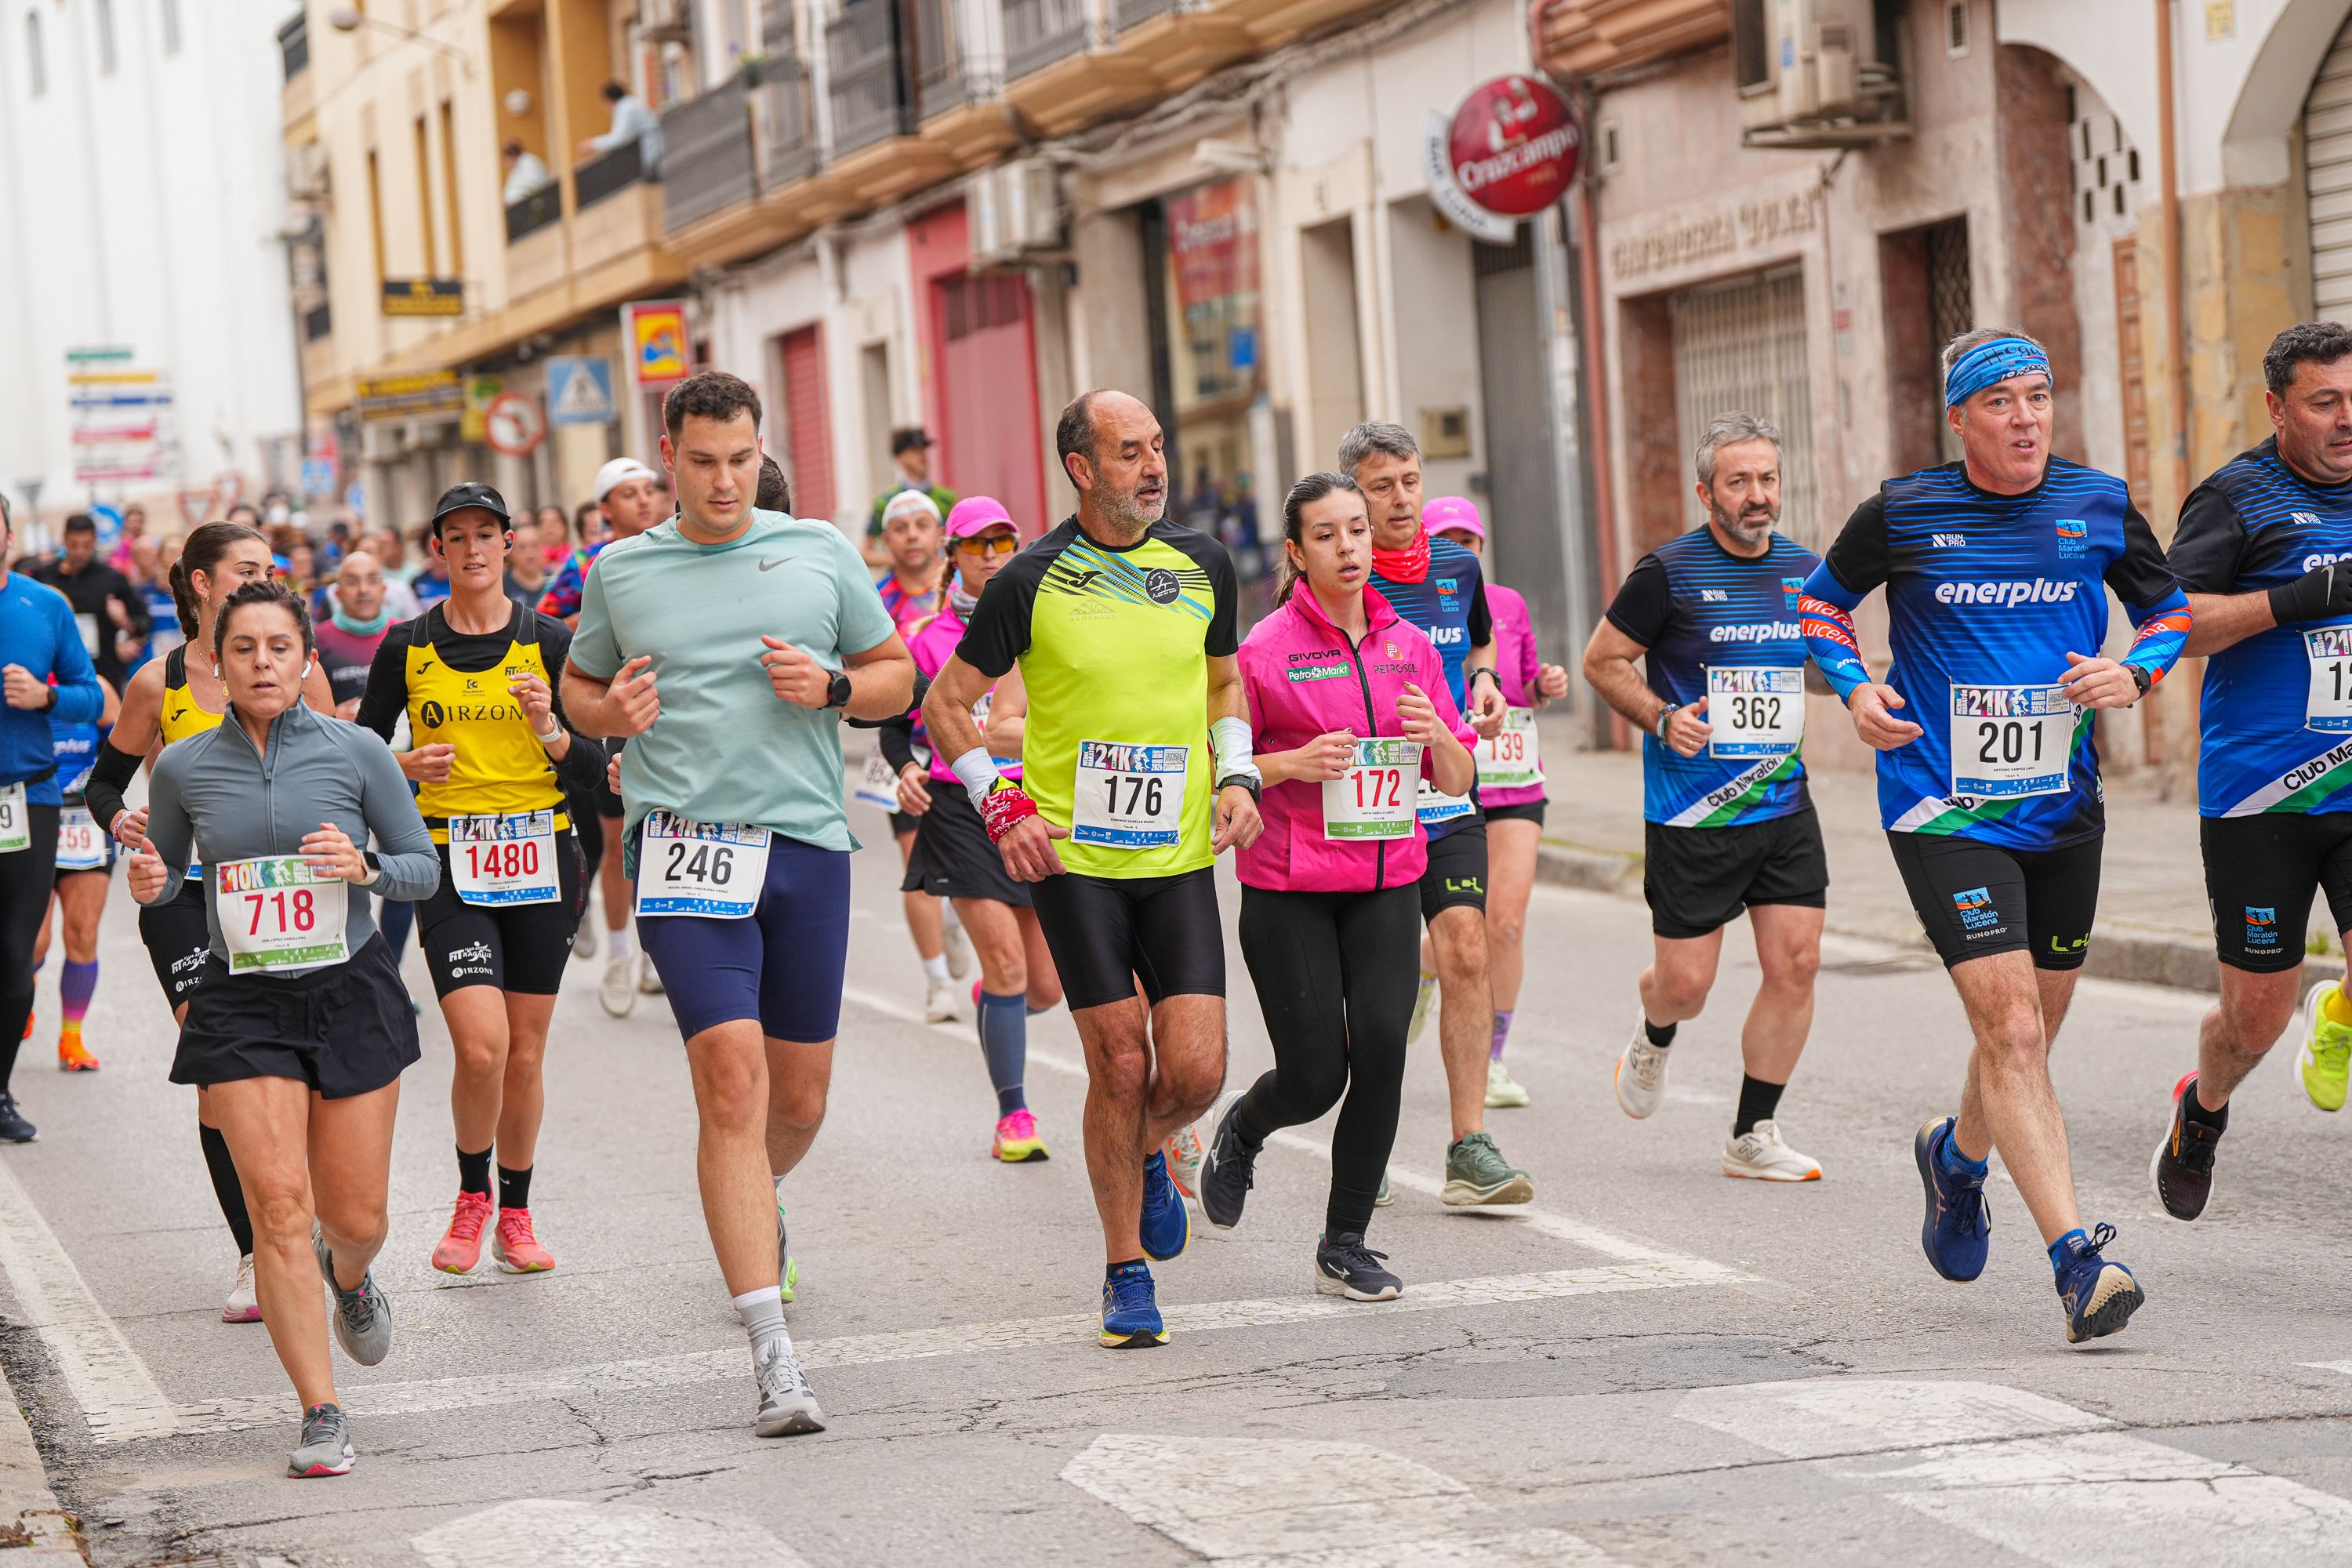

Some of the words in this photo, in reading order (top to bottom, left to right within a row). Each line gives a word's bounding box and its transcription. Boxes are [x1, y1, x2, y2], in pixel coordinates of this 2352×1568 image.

[1457, 124, 1579, 192] Cruzcampo
[2058, 537, 2076, 546] Club
[1934, 577, 2078, 608] enerplus
[1709, 620, 1801, 644] enerplus
[2325, 629, 2352, 656] 21
[1288, 649, 1341, 662] GIVOVA
[1374, 663, 1417, 674] PETROSOL
[1723, 670, 1755, 692] 21K
[1732, 696, 1781, 729] 362
[1969, 689, 2009, 716] 21K
[2031, 706, 2045, 714] 2026
[1491, 733, 1524, 760] 139
[1978, 720, 2043, 764] 201
[1094, 744, 1131, 771] 21K
[1151, 763, 1163, 771] 2026
[2283, 755, 2327, 792] Club
[1105, 775, 1163, 816] 176
[1350, 769, 1400, 808] 172
[1707, 785, 1737, 807] Club
[465, 818, 498, 841] 21K
[662, 812, 699, 837] 21K
[720, 833, 736, 842] 2026
[466, 841, 539, 878] 1480
[665, 842, 734, 884] 246
[227, 861, 266, 891] 10K
[245, 889, 314, 935] 718
[1960, 908, 1980, 917] Club
[1962, 909, 1998, 924] Maratón
[1965, 916, 1998, 930] Lucena
[2247, 936, 2276, 945] Lucena
